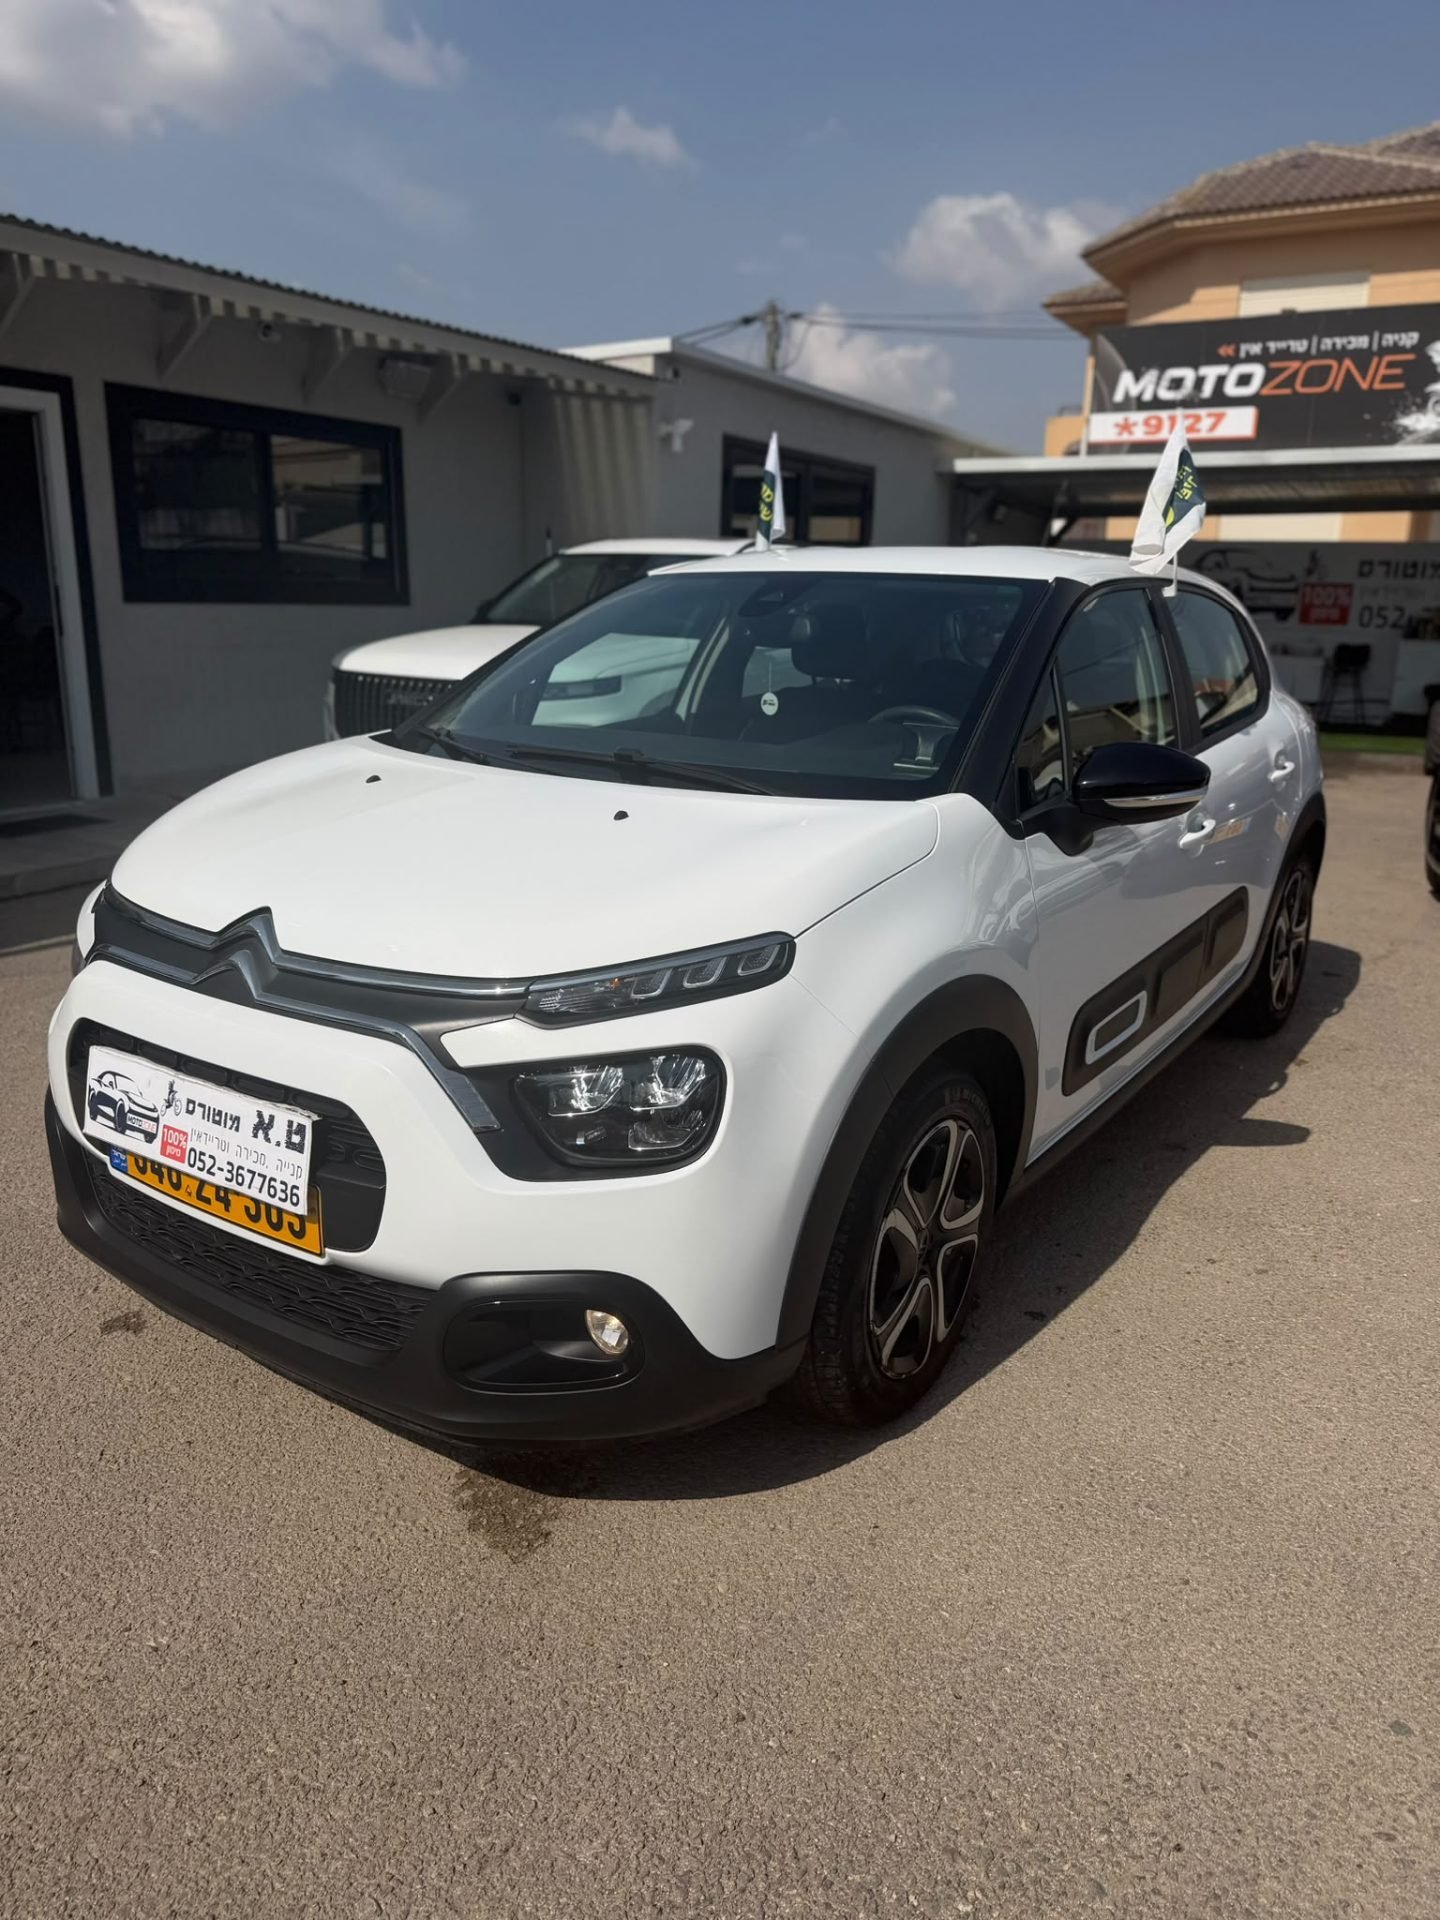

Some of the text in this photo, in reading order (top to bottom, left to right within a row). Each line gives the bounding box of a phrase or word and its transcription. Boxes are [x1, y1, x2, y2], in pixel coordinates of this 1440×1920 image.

[1239, 341, 1263, 359] אין
[1320, 335, 1370, 351] מכירה
[1381, 331, 1420, 349] קניה
[1112, 354, 1416, 403] MOTOZONE
[163, 1128, 187, 1149] 100%
[187, 1147, 300, 1207] 052-3677636
[276, 1158, 303, 1180] קנייה
